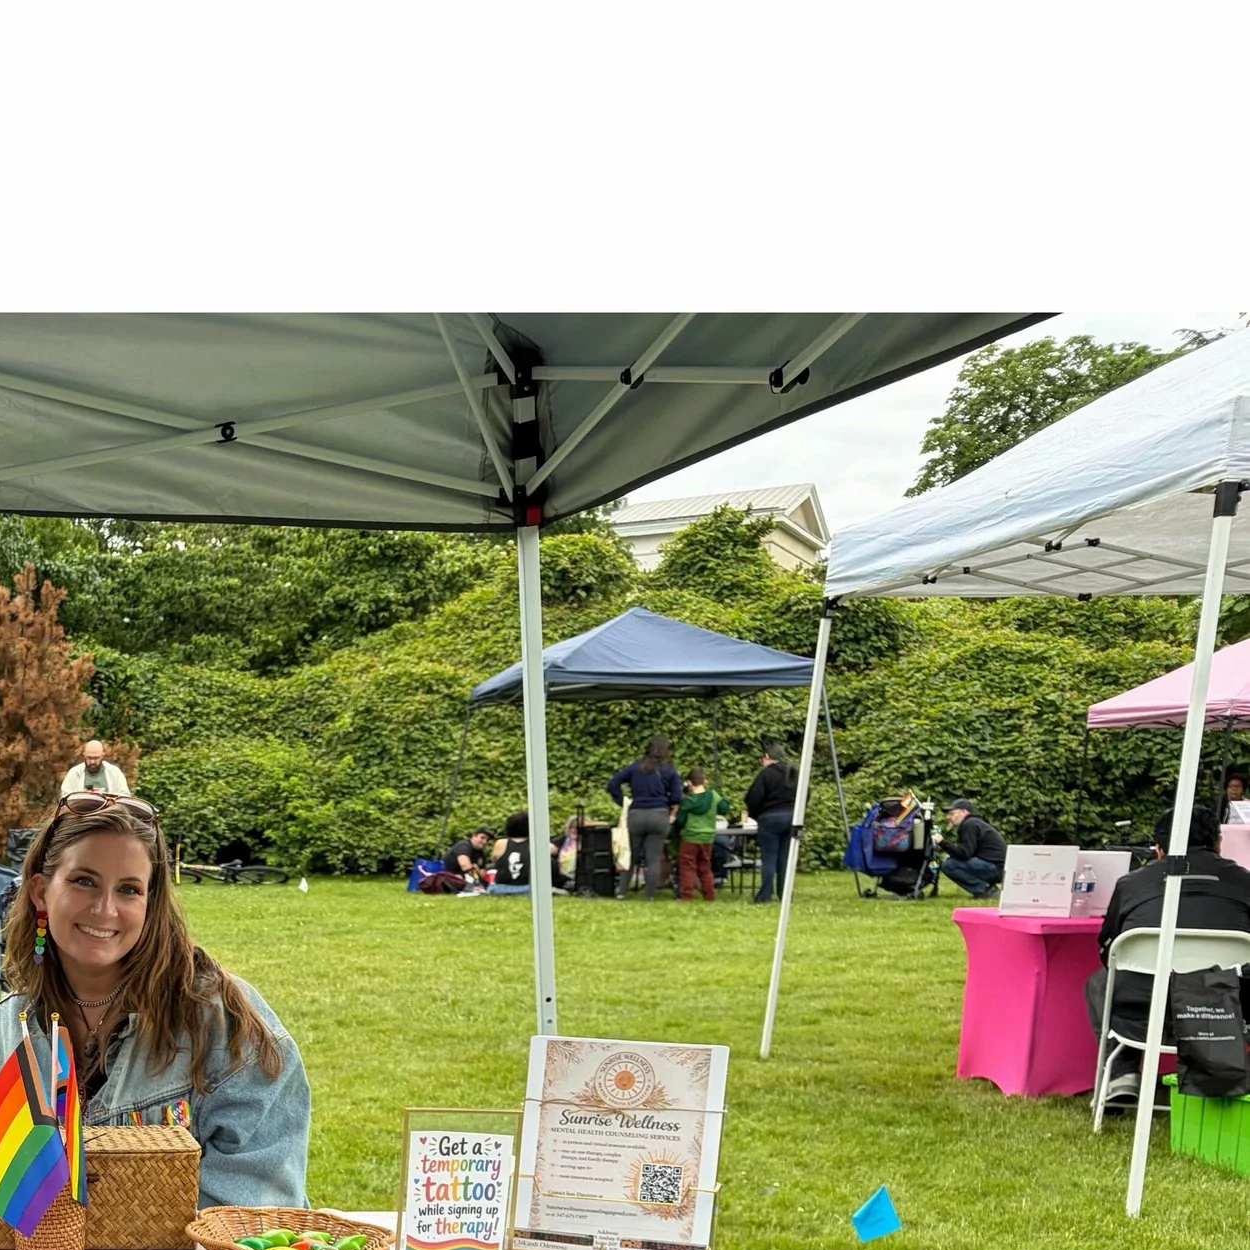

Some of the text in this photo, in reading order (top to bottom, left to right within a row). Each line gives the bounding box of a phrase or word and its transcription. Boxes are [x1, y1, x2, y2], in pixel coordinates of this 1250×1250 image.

[559, 1109, 681, 1132] Sunrise Wellness
[439, 1136, 483, 1156] Get a
[578, 1128, 604, 1136] HEALTH
[605, 1131, 649, 1140] COUNSELING
[650, 1134, 681, 1142] SERVICES
[421, 1155, 502, 1181] temporary
[422, 1176, 497, 1202] tattoo
[419, 1203, 499, 1219] while signing up
[417, 1217, 500, 1241] for therapy!
